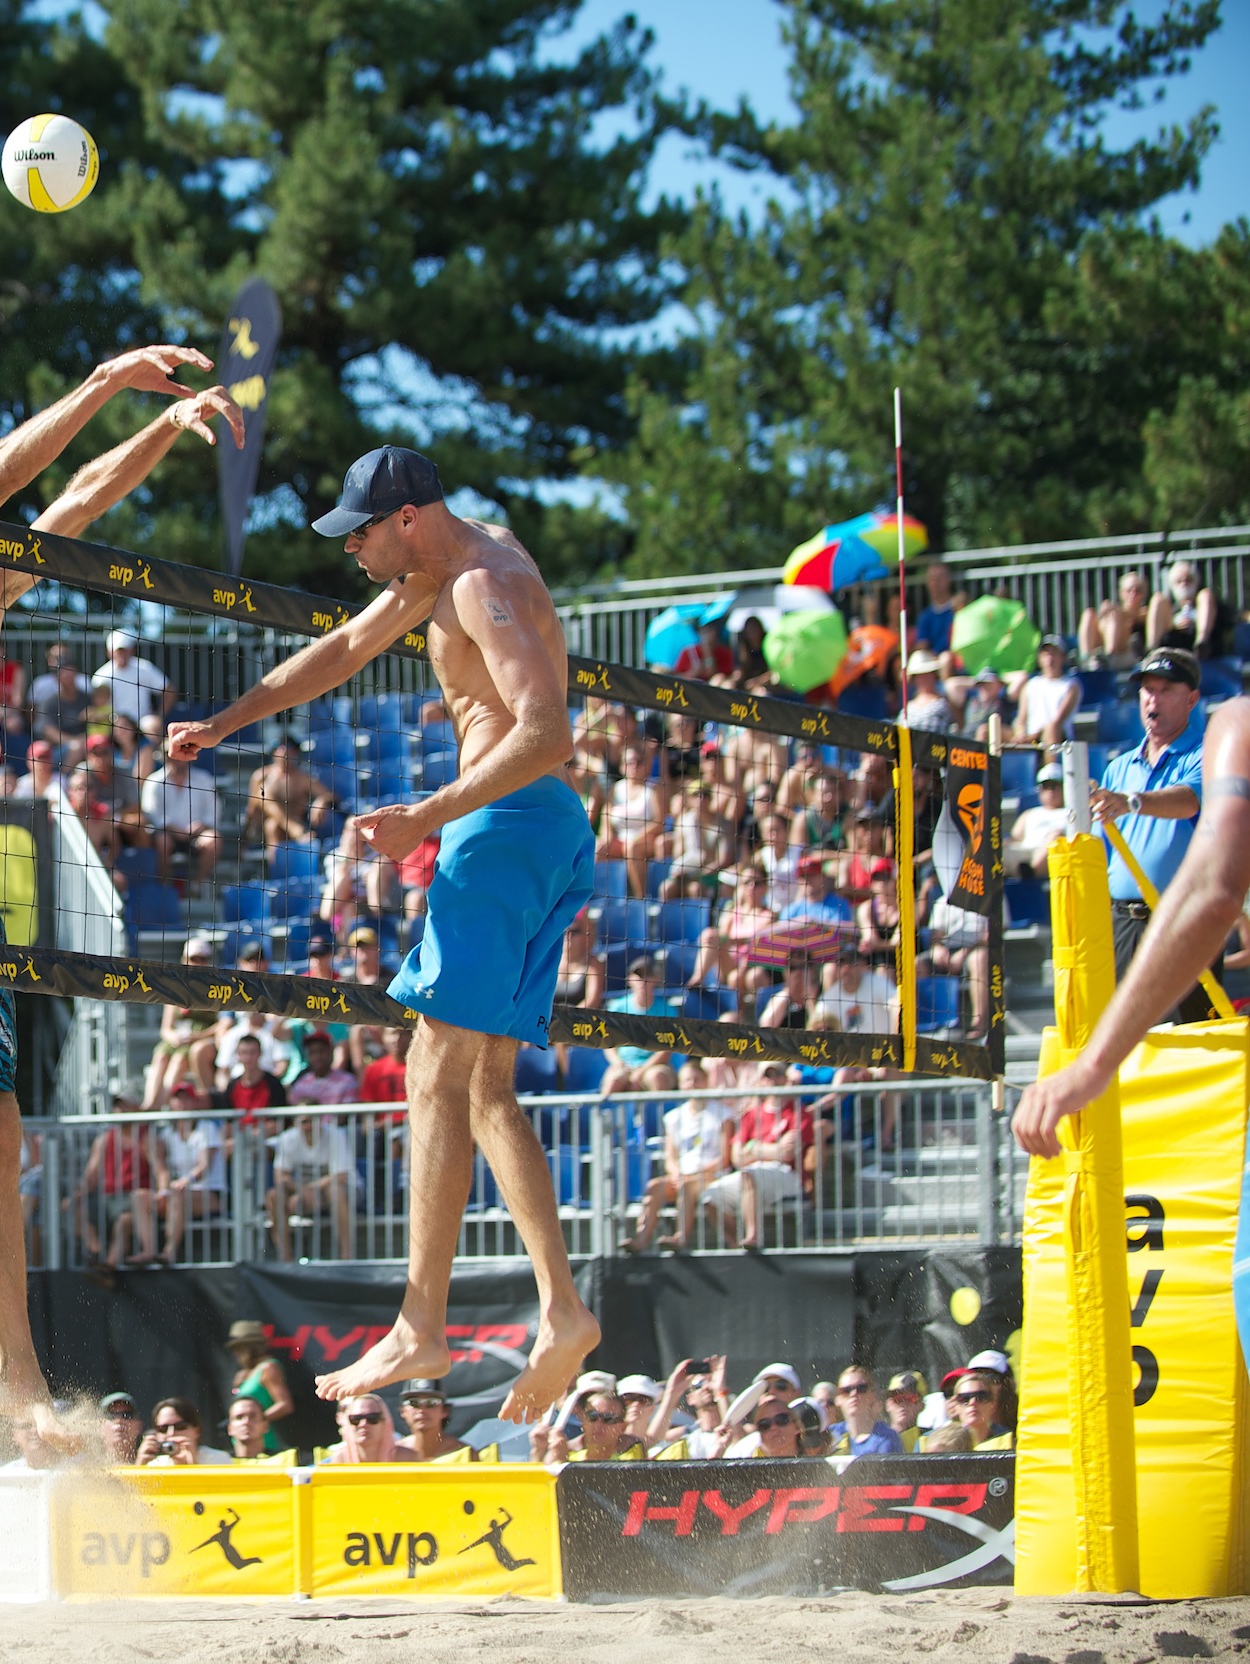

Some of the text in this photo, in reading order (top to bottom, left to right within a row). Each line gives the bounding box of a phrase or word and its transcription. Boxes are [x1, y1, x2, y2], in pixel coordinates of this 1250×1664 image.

[14, 149, 56, 162] Wilson
[77, 140, 89, 177] Wilson
[109, 565, 133, 586] avp
[214, 589, 235, 609] avp
[312, 612, 332, 632] avp
[405, 632, 425, 652] avp
[577, 670, 596, 688] avp
[731, 704, 748, 720] avp
[103, 974, 129, 993] avp
[208, 986, 232, 1004] avp
[306, 996, 330, 1014] avp
[403, 1007, 419, 1020] av
[573, 1023, 593, 1040] avp
[728, 1038, 748, 1054] avp
[81, 1530, 170, 1577] avp
[344, 1531, 438, 1578] avp
